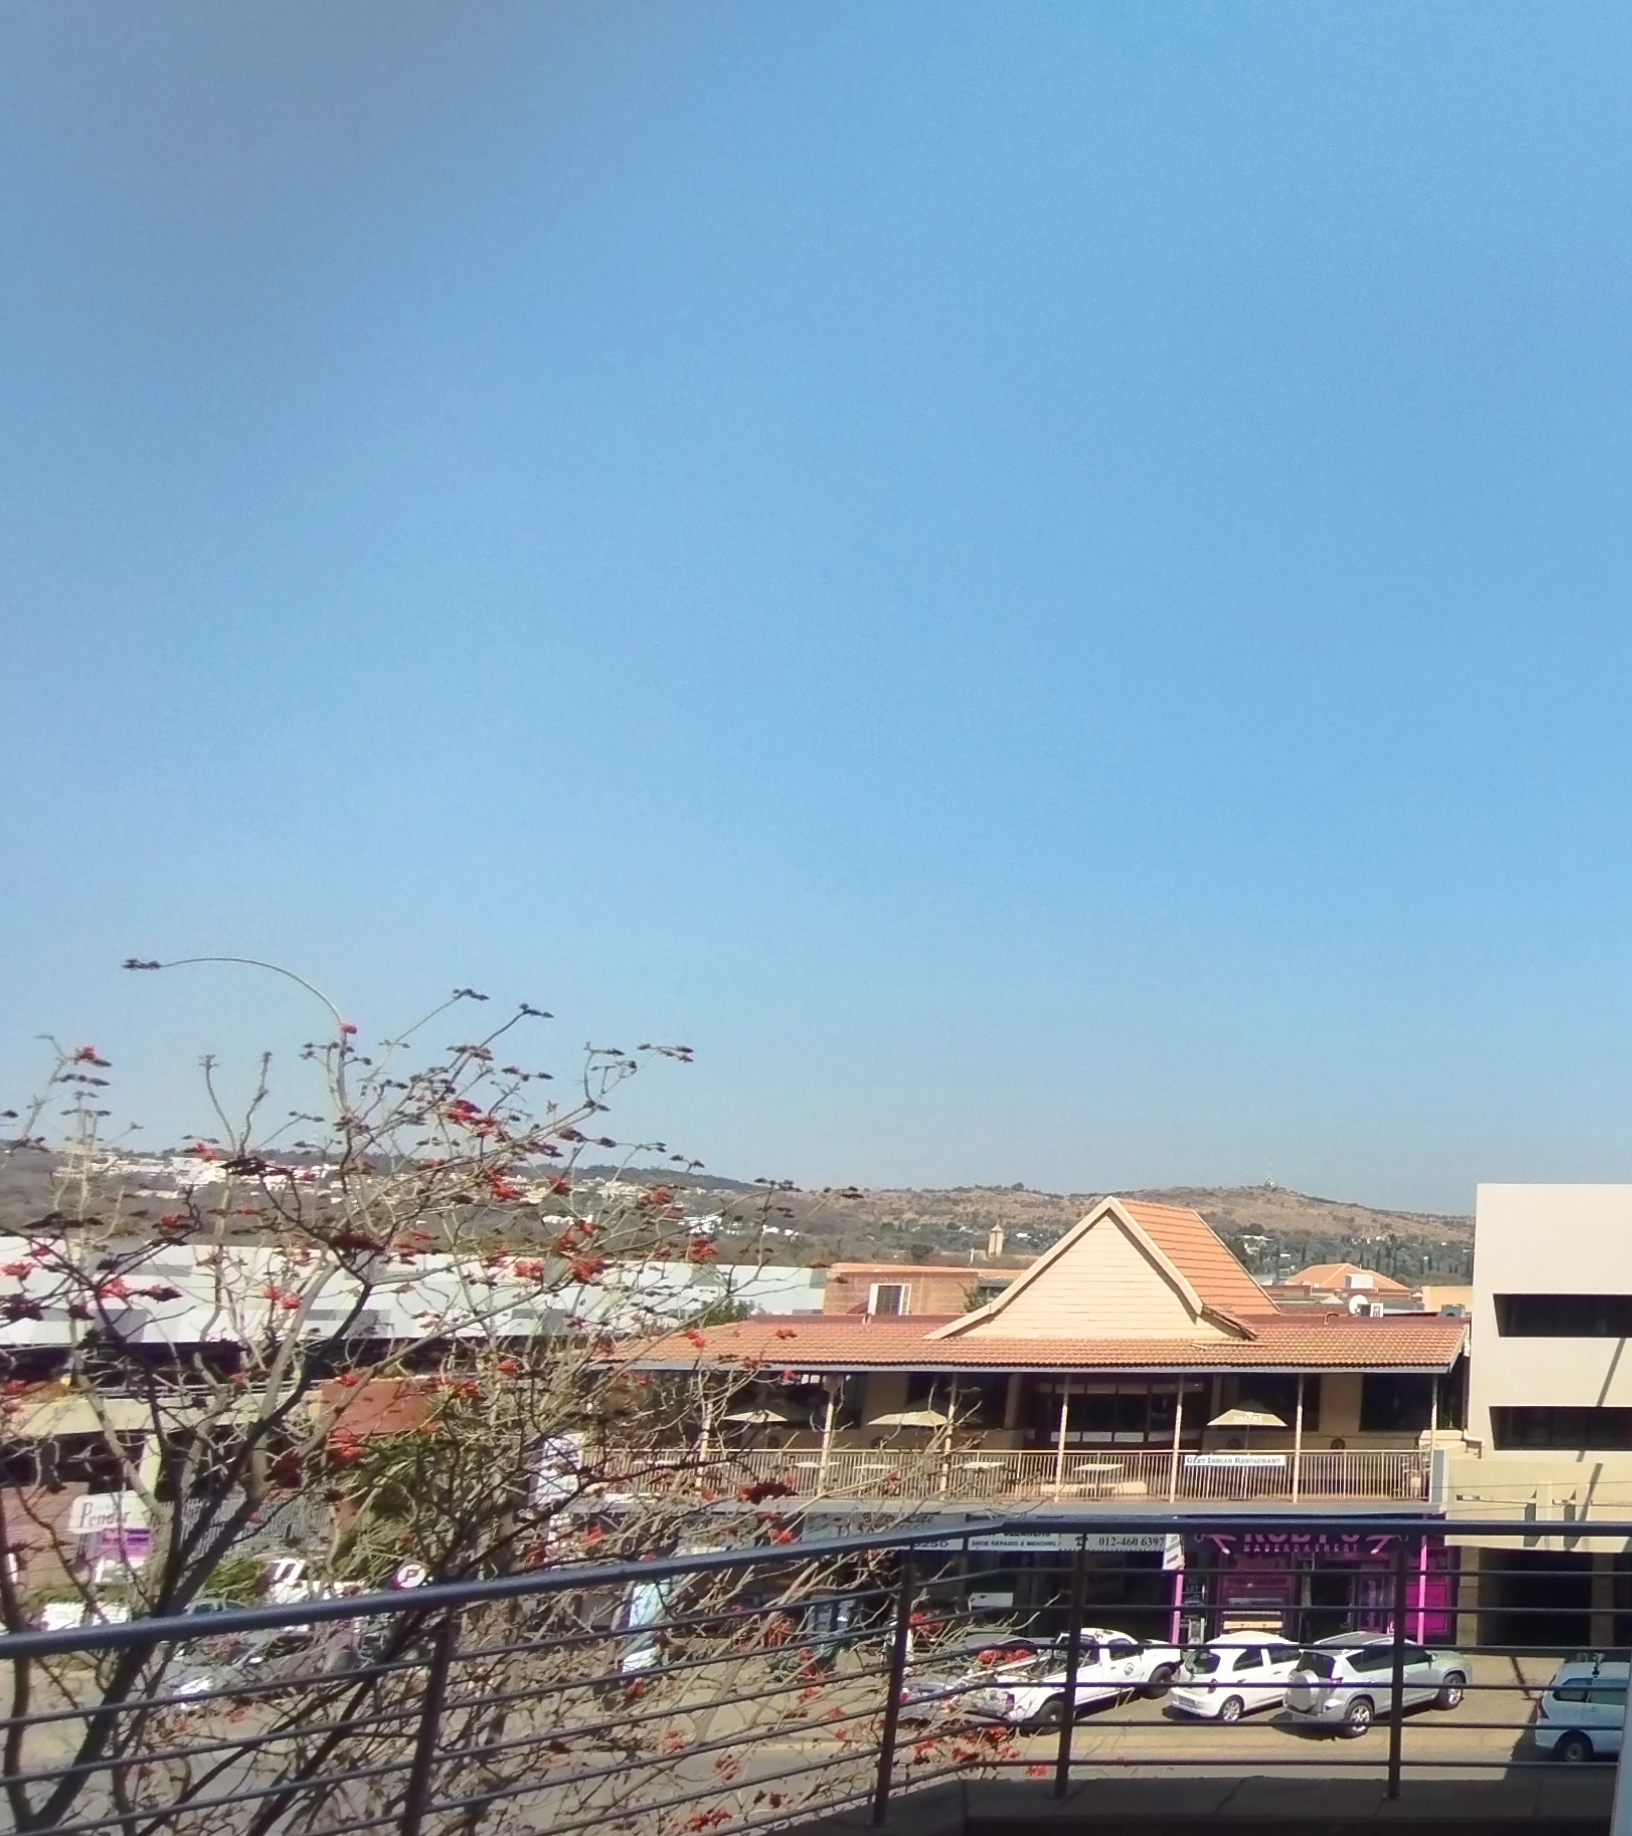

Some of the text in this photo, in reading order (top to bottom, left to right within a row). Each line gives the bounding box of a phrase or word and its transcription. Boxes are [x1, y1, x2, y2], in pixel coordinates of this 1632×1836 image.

[1207, 1456, 1233, 1464] INDIAN
[1235, 1456, 1281, 1464] RESTAURANT
[1244, 1543, 1358, 1552] HABERDASHERY
